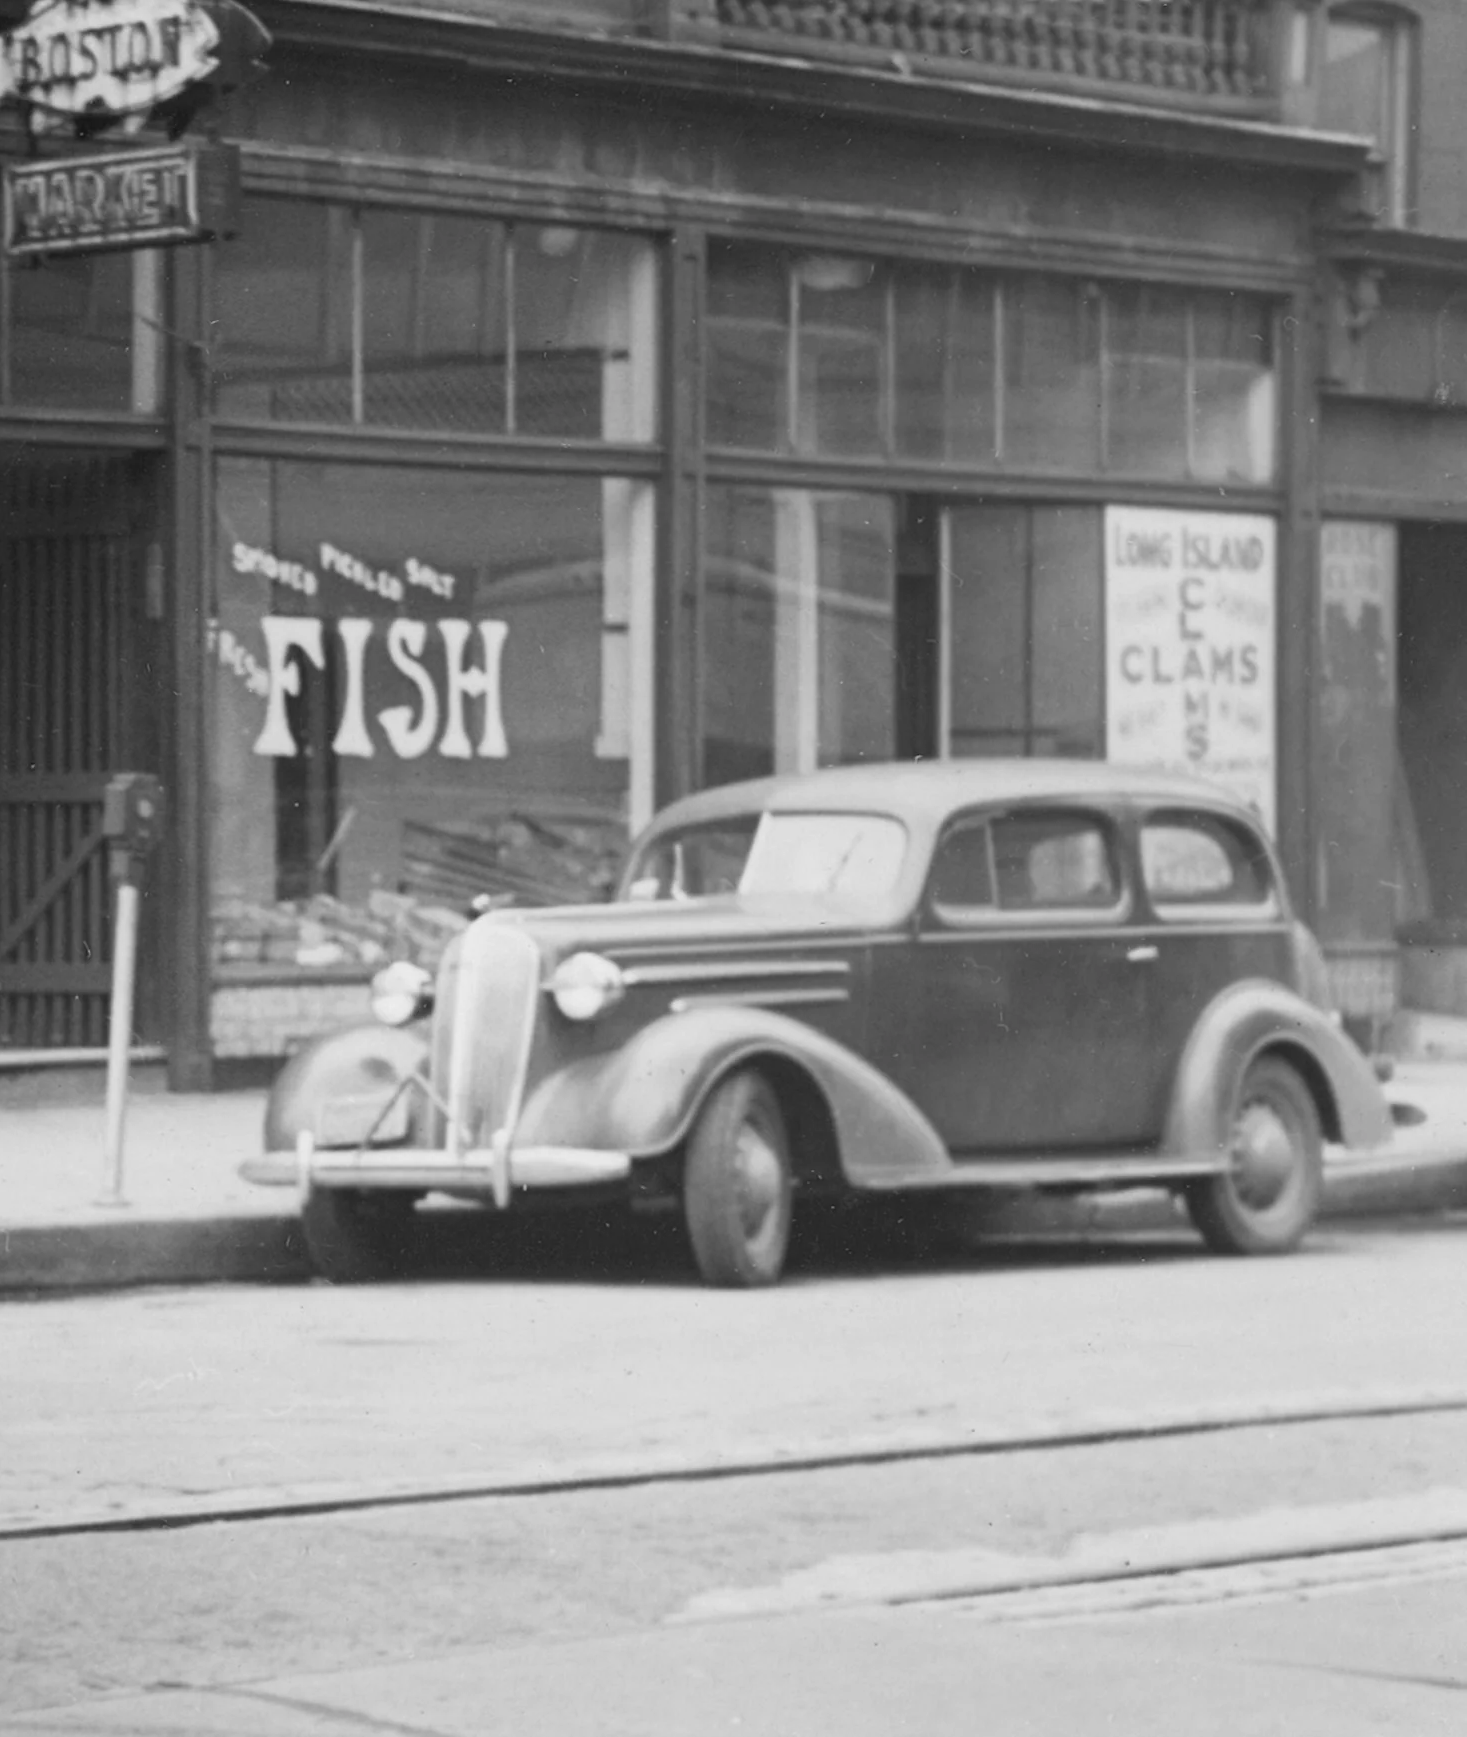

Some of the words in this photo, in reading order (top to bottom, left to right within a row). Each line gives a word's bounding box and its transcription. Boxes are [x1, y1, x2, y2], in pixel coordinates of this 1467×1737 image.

[18, 16, 183, 90] BOSTON
[13, 159, 189, 237] MARKET
[1115, 522, 1172, 569] LONG
[1180, 526, 1264, 572] ISLAND
[252, 615, 509, 759] FISH
[1119, 644, 1260, 685] CLAMS
